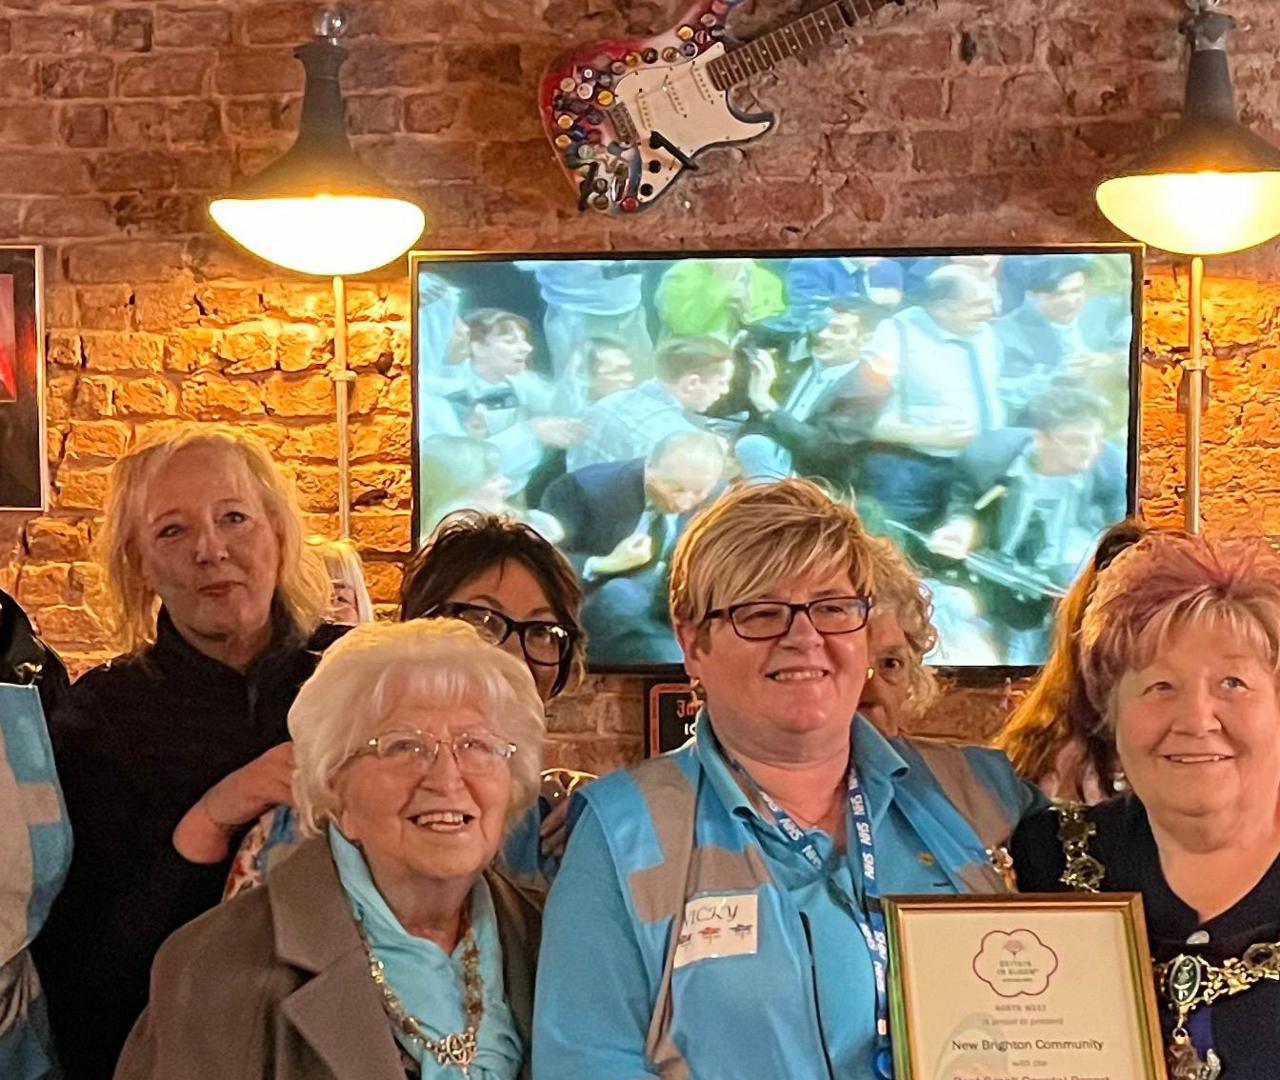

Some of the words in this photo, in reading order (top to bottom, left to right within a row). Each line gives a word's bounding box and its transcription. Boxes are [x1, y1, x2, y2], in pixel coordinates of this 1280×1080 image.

[779, 818, 805, 841] NHS
[856, 822, 872, 846] NHS
[862, 852, 874, 880] NHS
[952, 1040, 978, 1050] New
[981, 1039, 1032, 1052] Brighton
[1035, 1039, 1104, 1051] Community
